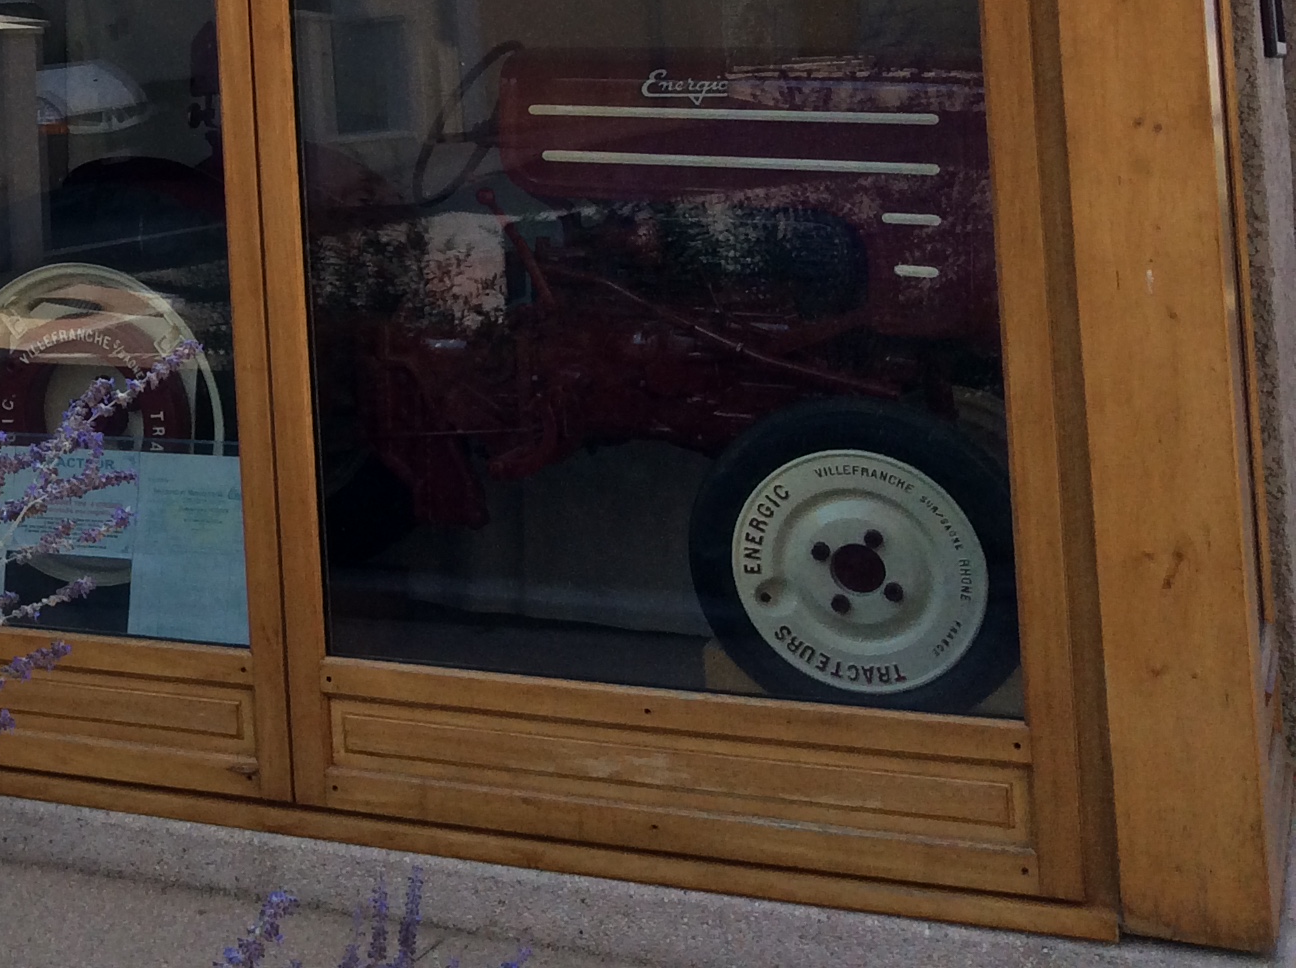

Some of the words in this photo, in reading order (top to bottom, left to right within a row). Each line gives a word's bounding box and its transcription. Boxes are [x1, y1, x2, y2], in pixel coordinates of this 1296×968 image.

[642, 69, 728, 105] Energic
[20, 329, 111, 364] VILLEFRANCHE
[744, 484, 790, 574] ENERGIC
[815, 465, 915, 494] VILLEFRANCHE
[959, 559, 972, 601] RHONE
[774, 625, 906, 683] TRACTEURS
